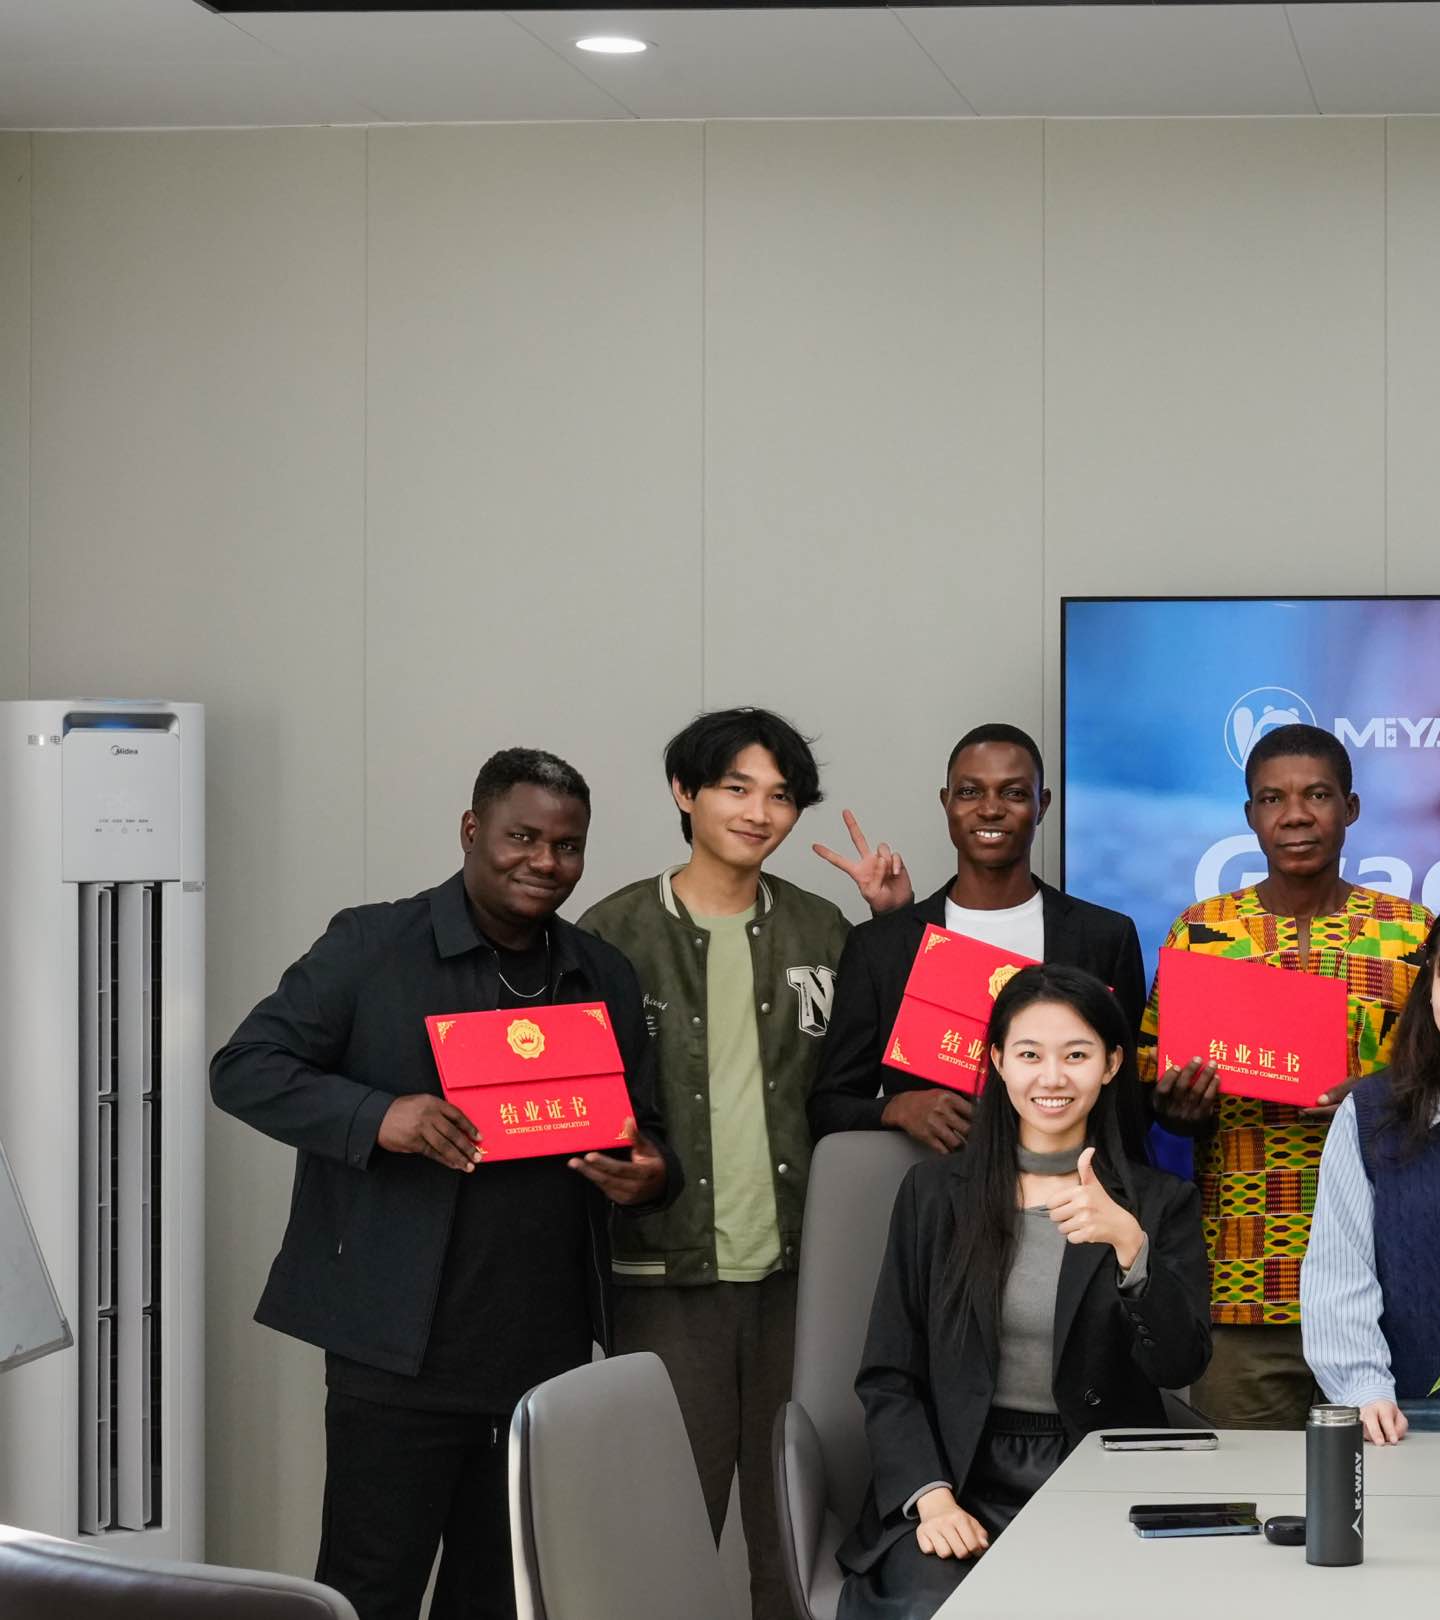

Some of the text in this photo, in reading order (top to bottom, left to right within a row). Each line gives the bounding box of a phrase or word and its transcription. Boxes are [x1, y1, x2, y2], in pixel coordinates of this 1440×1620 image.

[1209, 1039, 1300, 1072] 结业证书
[1260, 1071, 1299, 1083] COMPLETION
[500, 1096, 587, 1124] 结业证书
[1354, 1452, 1362, 1510] K-WAY
